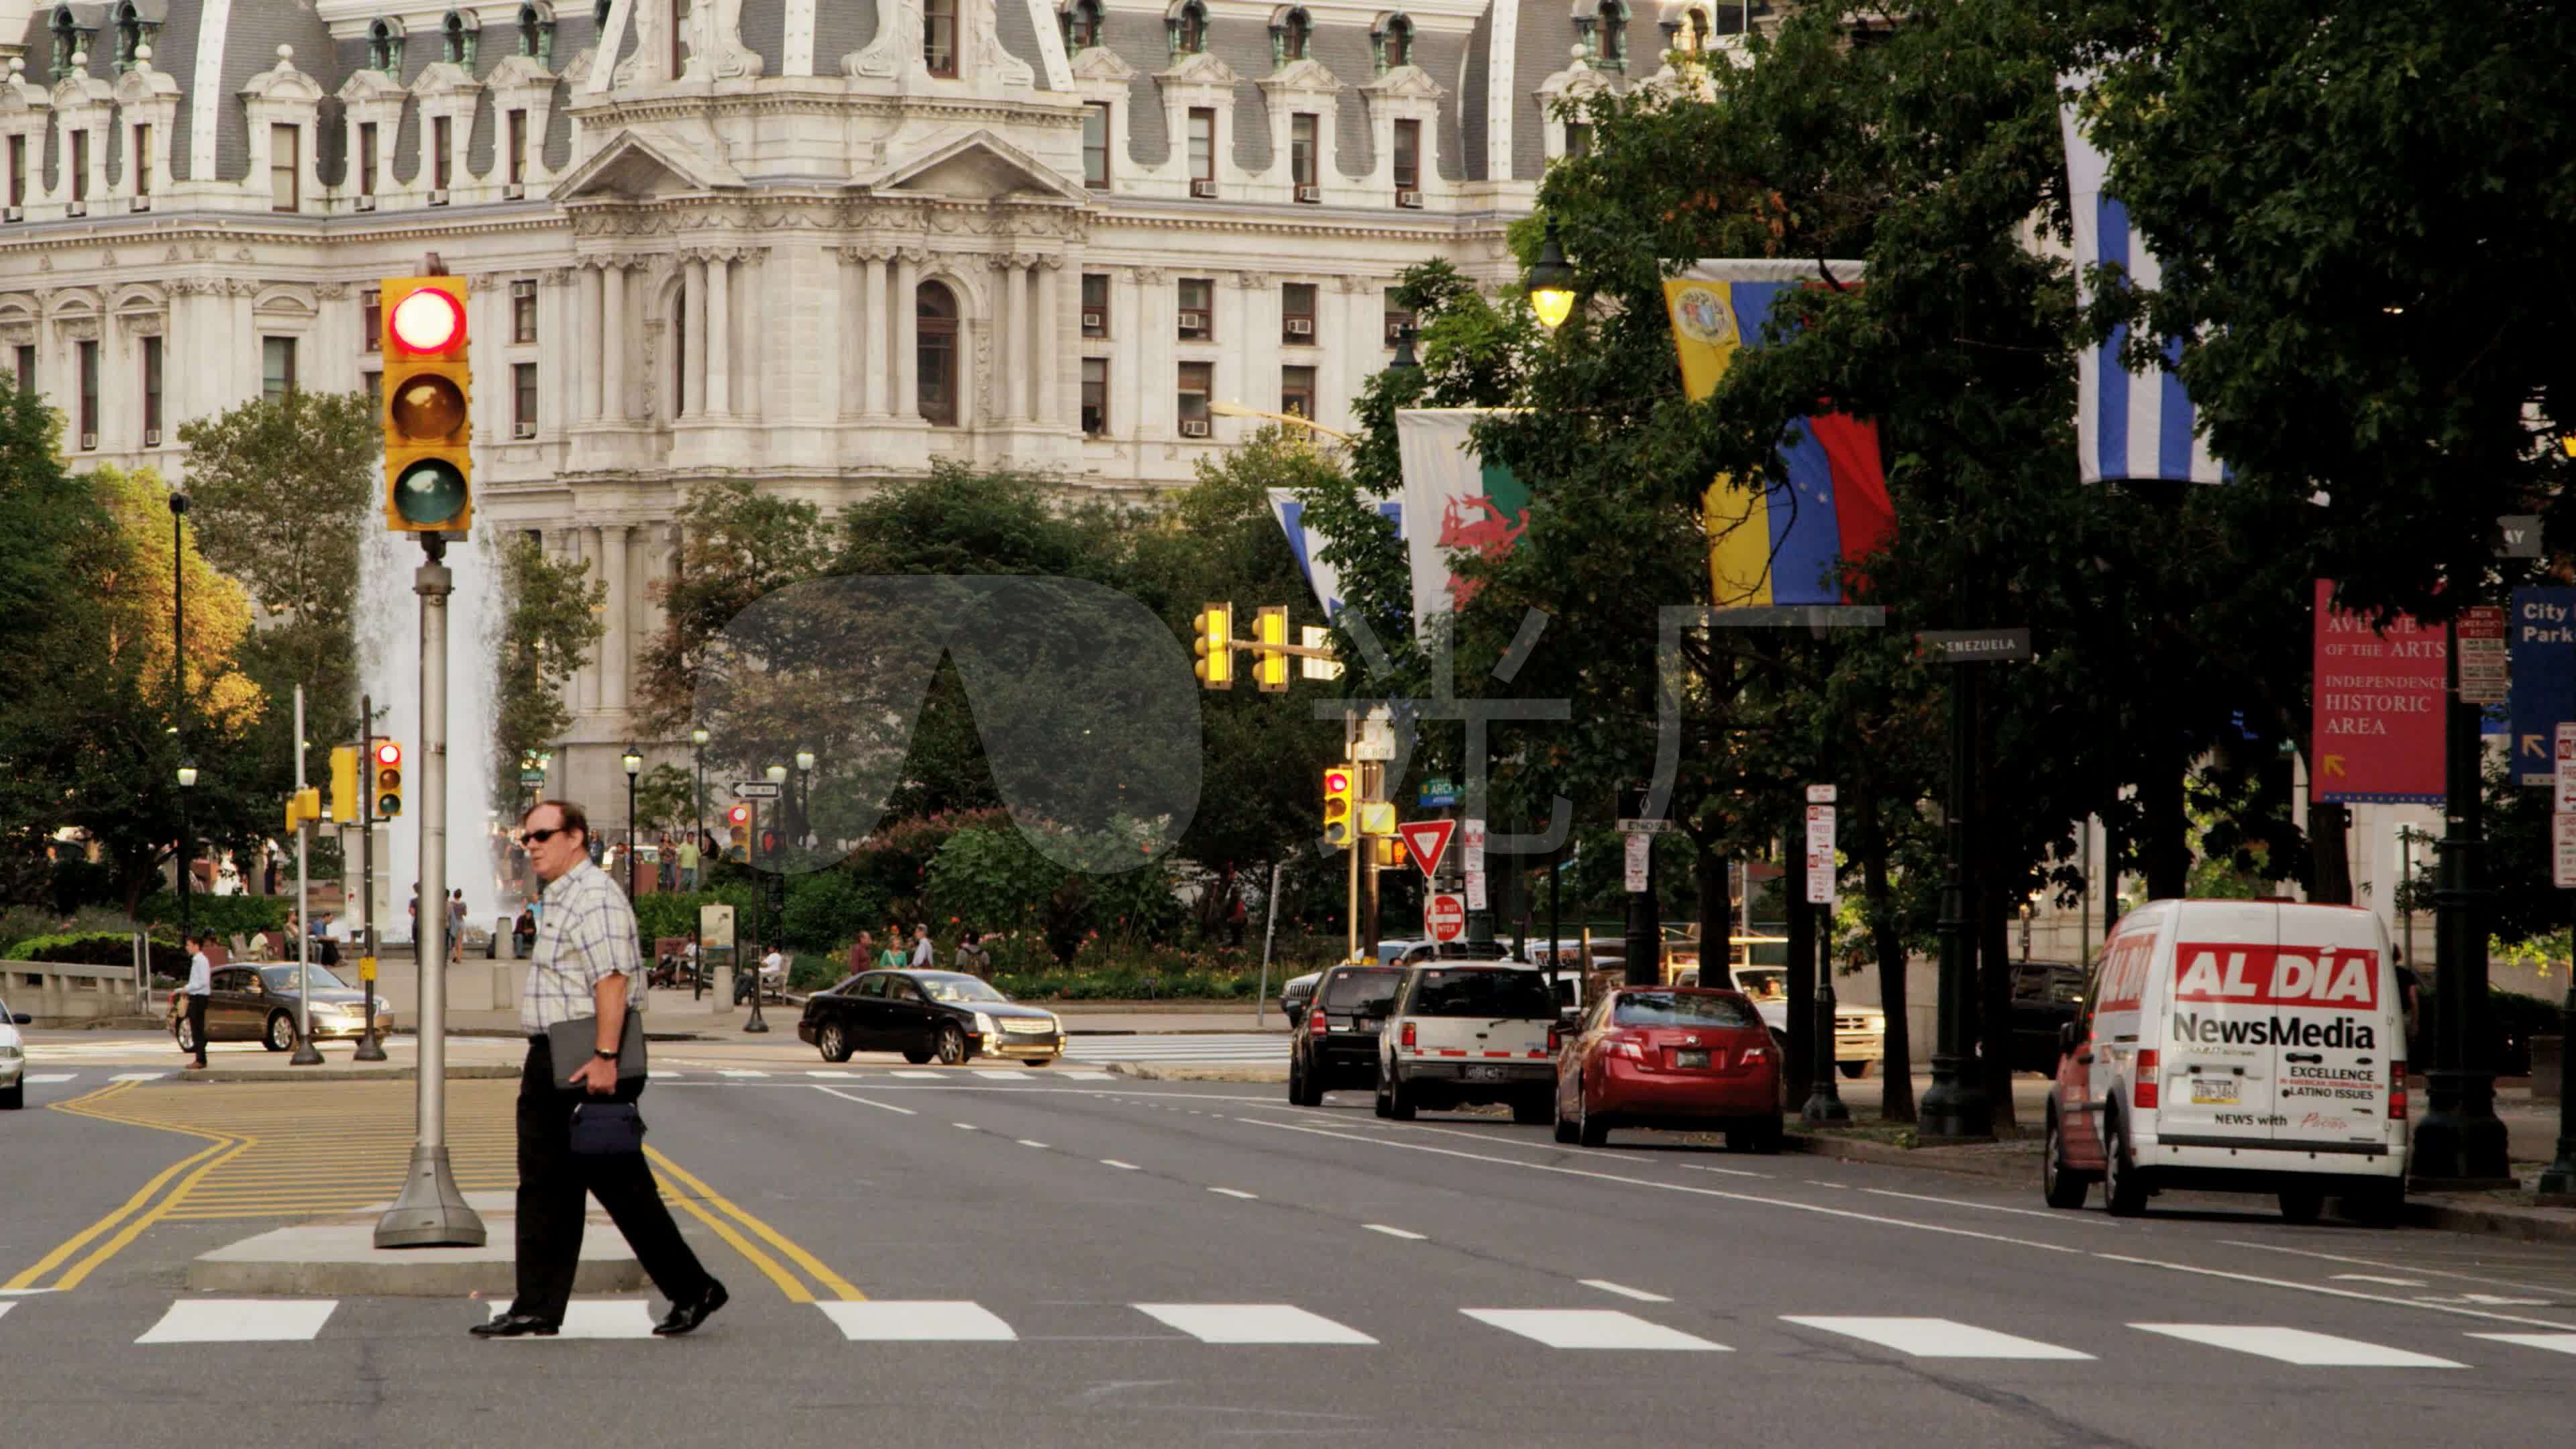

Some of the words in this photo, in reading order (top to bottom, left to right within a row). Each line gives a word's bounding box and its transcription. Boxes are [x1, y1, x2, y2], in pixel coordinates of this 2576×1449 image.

[2522, 602, 2568, 623] City
[2325, 616, 2417, 634] AVEUE
[2522, 626, 2576, 644] Park
[2324, 643, 2347, 656] OF
[2350, 643, 2383, 657] THE
[2391, 641, 2447, 658] ARTS
[2324, 675, 2448, 689] INDEPENDENCE
[2324, 693, 2432, 712] HISTORIC
[2324, 716, 2387, 735] AREA
[1438, 924, 1456, 933] NTER
[2178, 951, 2257, 998] AL
[2267, 943, 2373, 1003] DÍA
[2173, 1012, 2375, 1050] NewsMedia
[2290, 1066, 2374, 1082] EXCELLENCE
[2290, 1086, 2333, 1098] LATINO
[2334, 1089, 2373, 1101] ISSUES
[2215, 1114, 2253, 1125] NEWS
[2258, 1114, 2288, 1127] with
